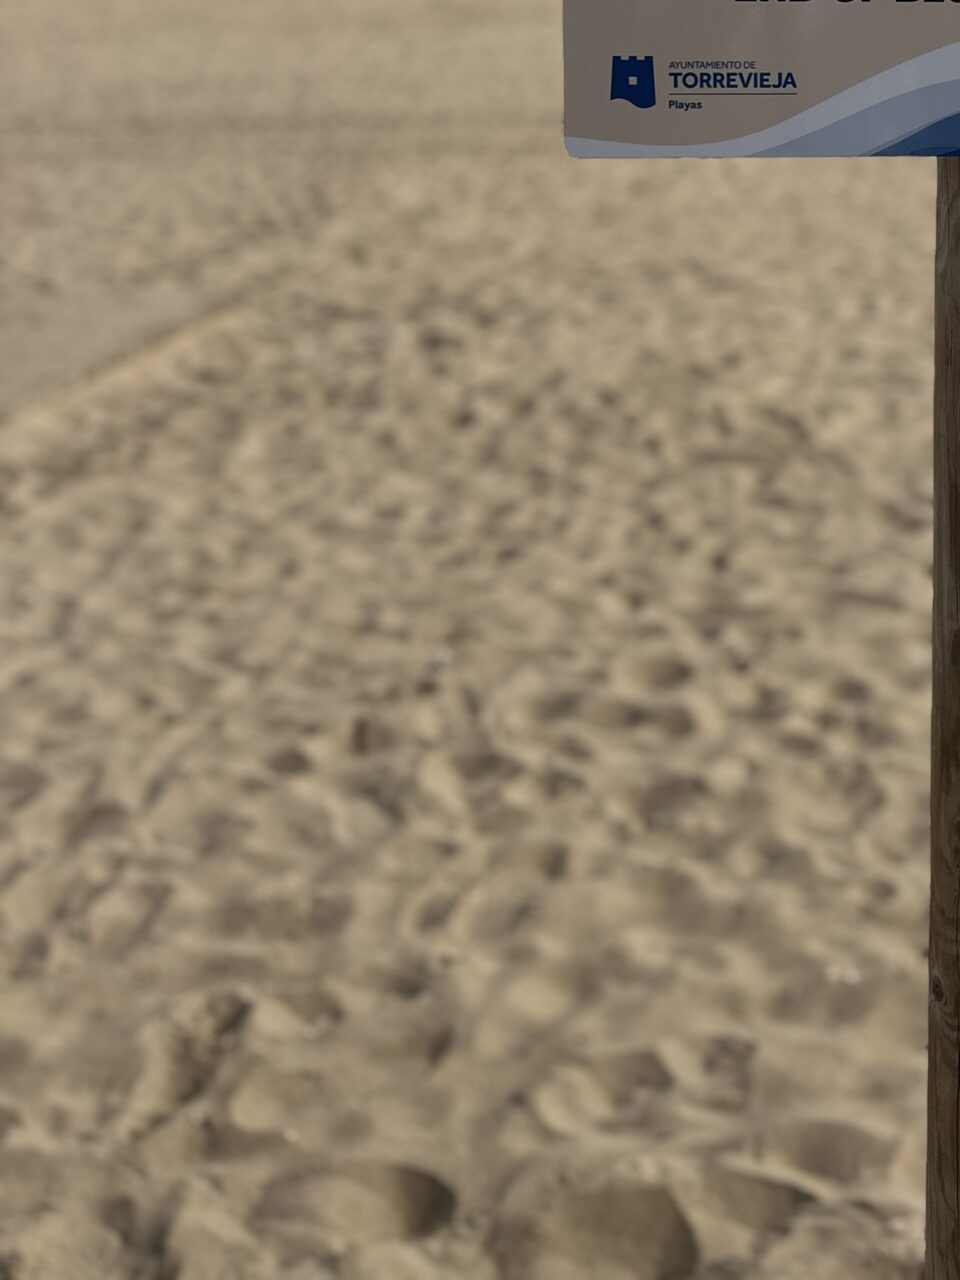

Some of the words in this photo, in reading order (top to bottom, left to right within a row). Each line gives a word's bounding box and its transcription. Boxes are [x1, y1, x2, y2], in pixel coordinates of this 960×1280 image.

[668, 60, 742, 70] AYUNTAMIENTO
[743, 60, 757, 70] DE
[668, 72, 798, 89] TORREVIEJA
[668, 99, 703, 111] Playas
